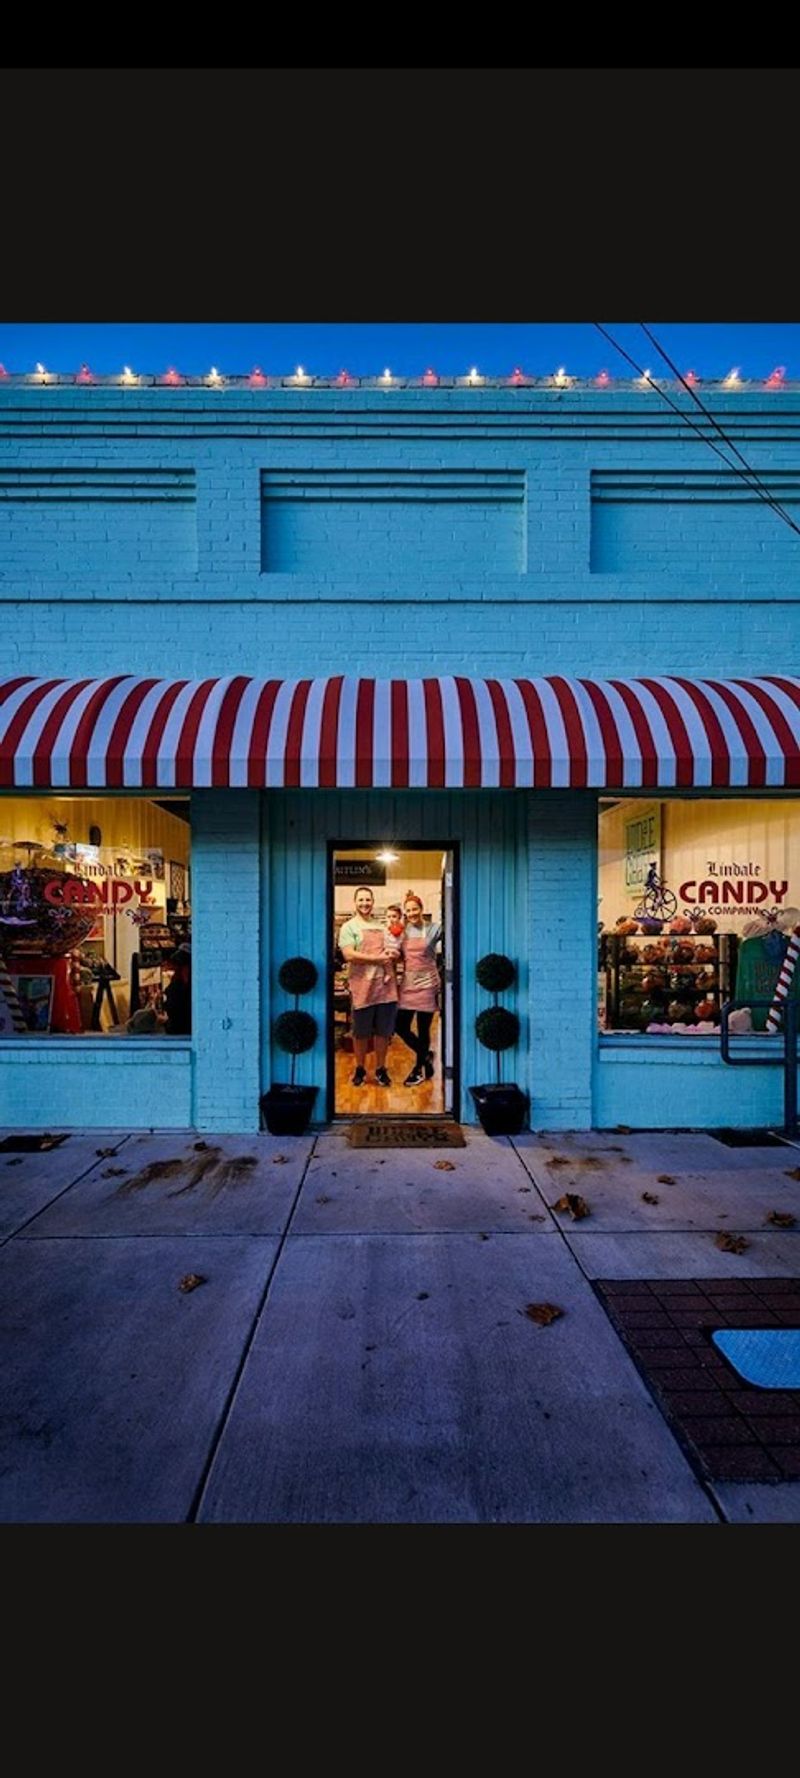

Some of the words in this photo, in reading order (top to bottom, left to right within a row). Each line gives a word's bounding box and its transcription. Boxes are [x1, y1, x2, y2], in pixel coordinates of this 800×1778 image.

[74, 861, 125, 877] Lindale
[707, 861, 762, 877] Lindale
[44, 880, 152, 904] CANDY
[679, 880, 788, 904] CANDY
[708, 906, 759, 916] COMPANY
